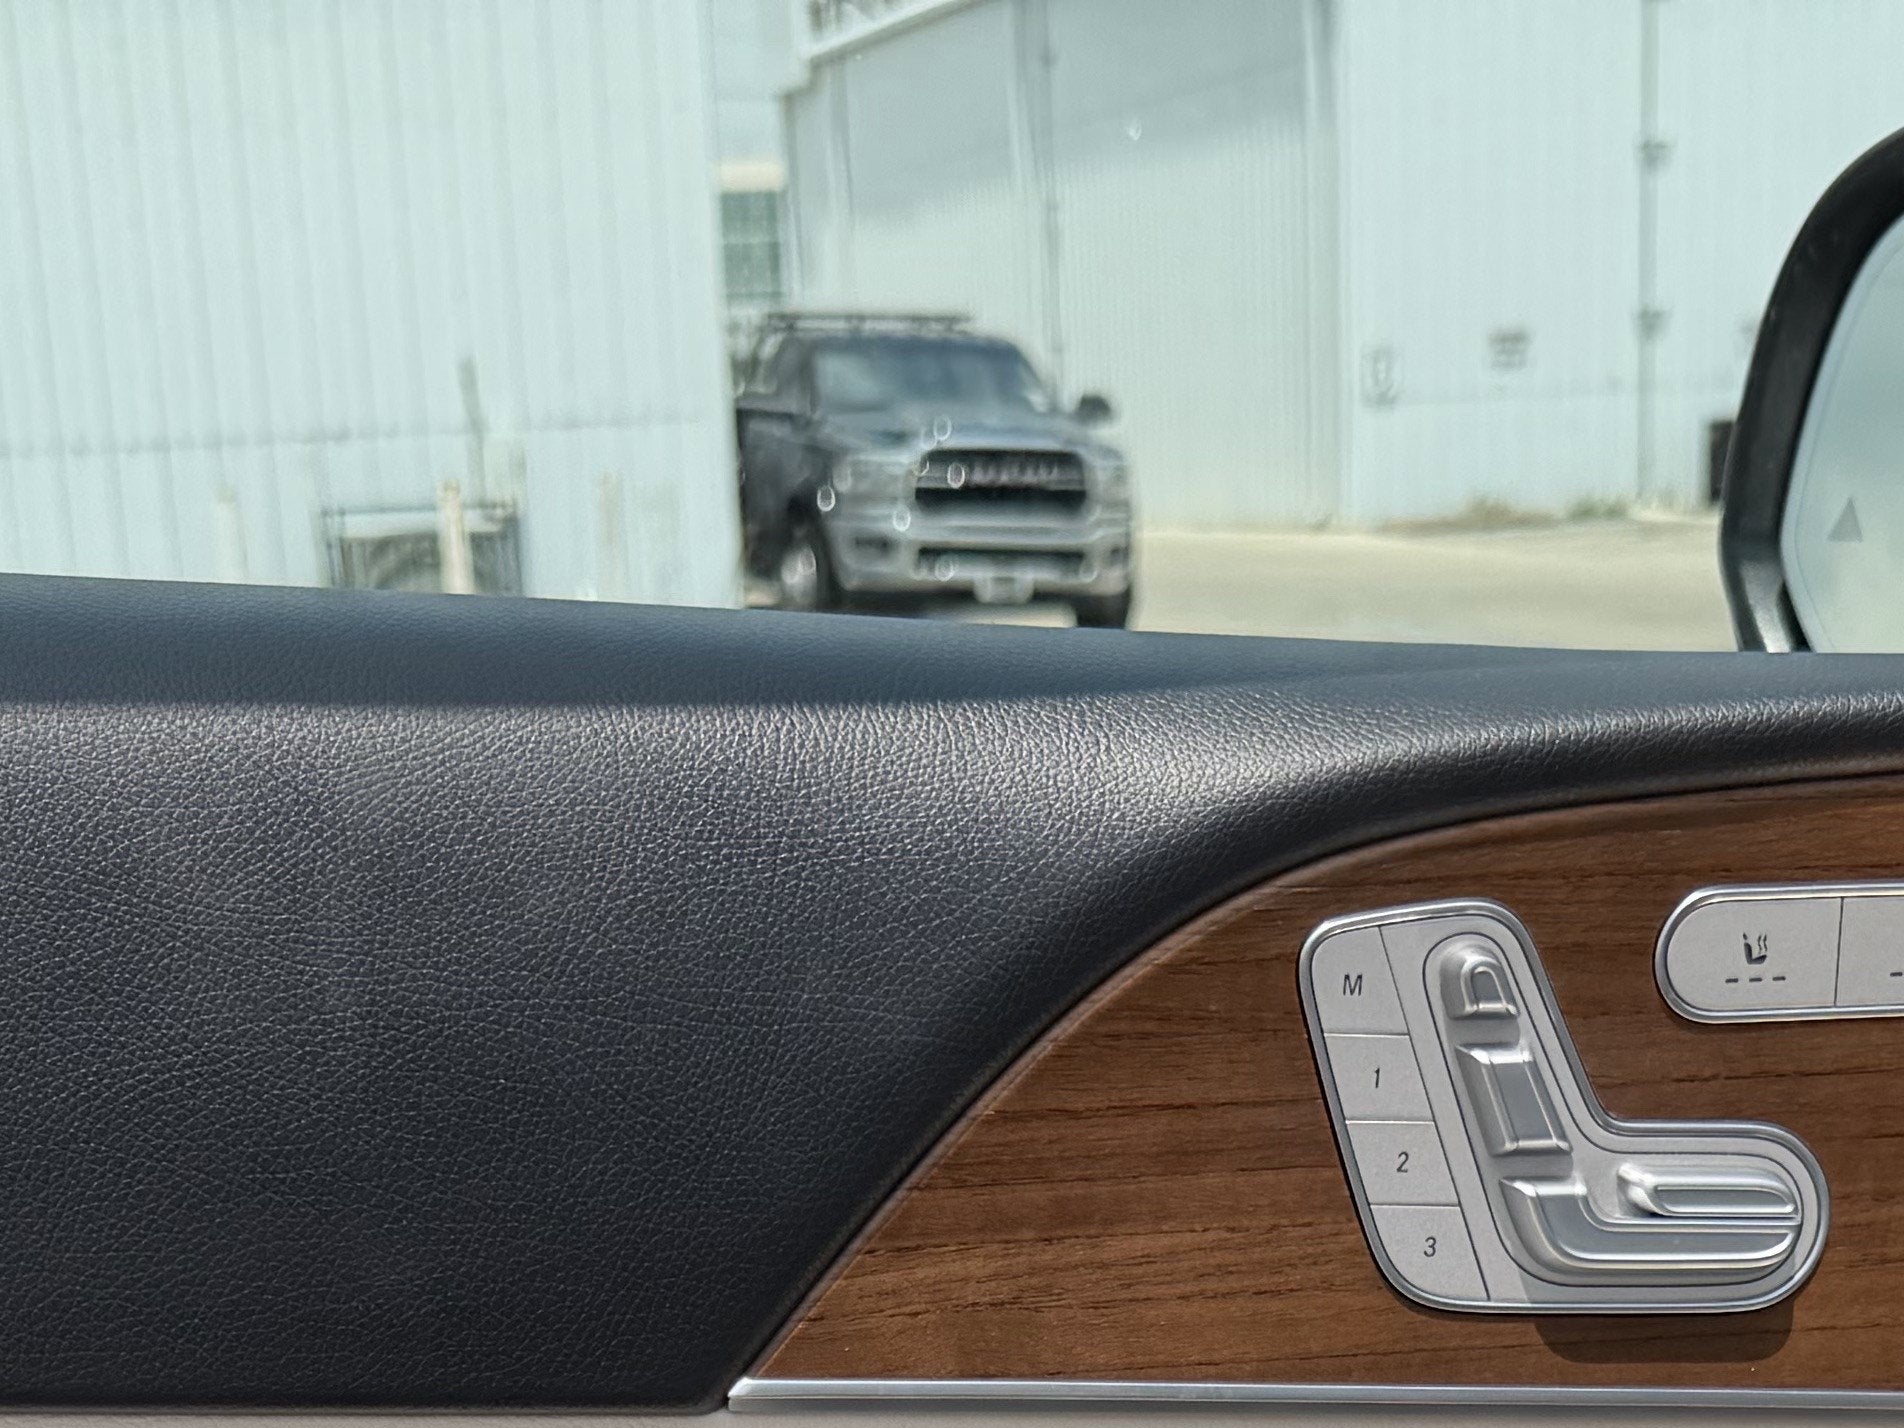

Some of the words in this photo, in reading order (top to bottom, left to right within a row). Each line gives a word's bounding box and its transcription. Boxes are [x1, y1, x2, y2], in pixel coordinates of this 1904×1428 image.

[1342, 973, 1364, 998] M
[1372, 1067, 1381, 1089] 1
[1396, 1152, 1410, 1174] 2
[1423, 1236, 1438, 1258] 3
